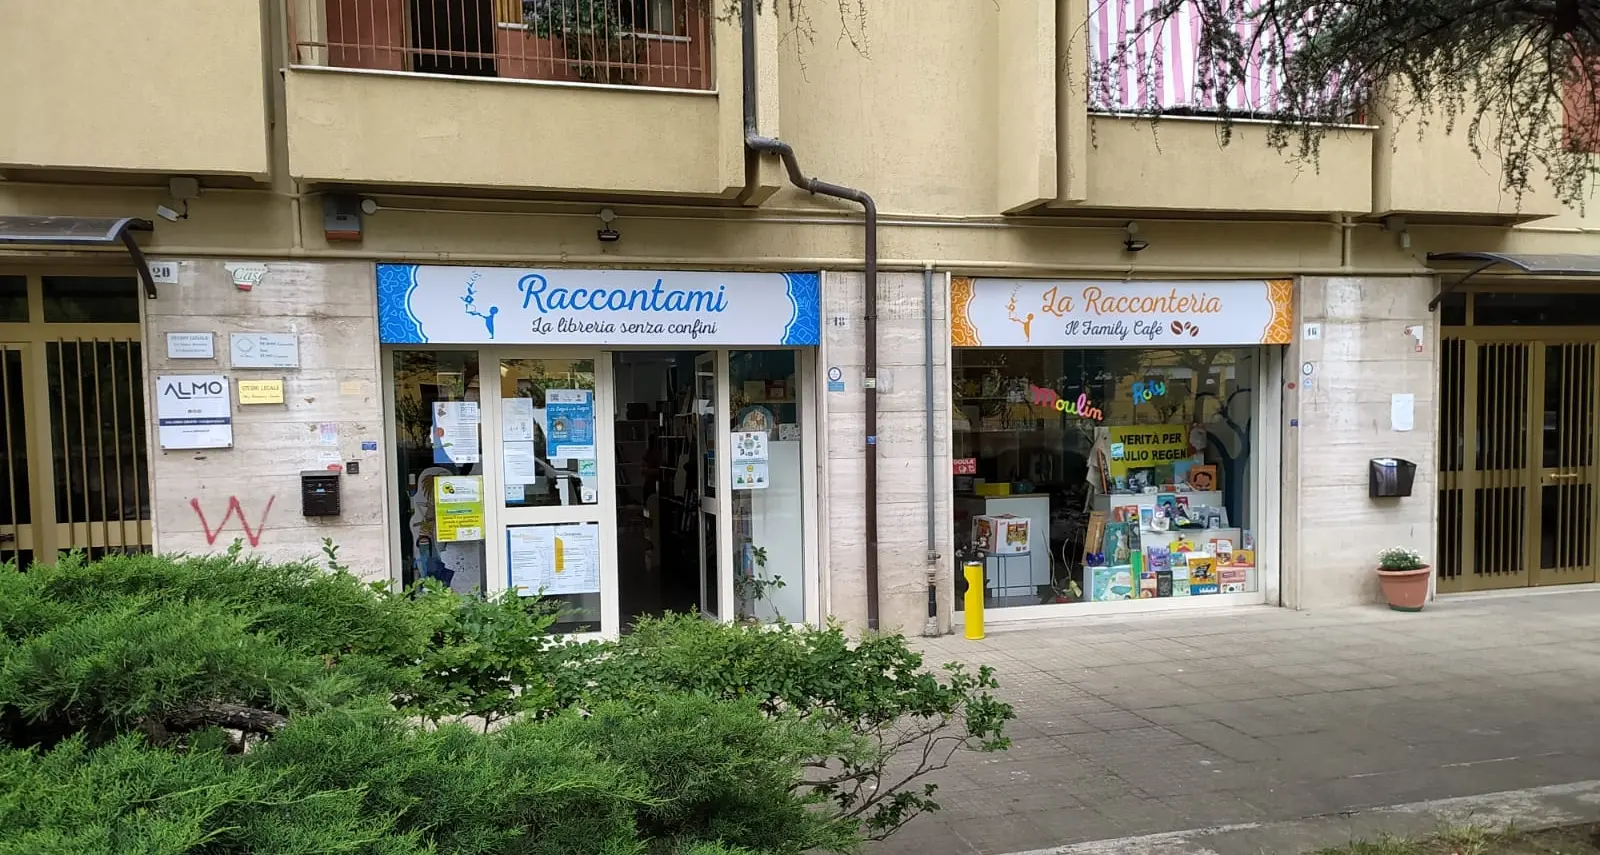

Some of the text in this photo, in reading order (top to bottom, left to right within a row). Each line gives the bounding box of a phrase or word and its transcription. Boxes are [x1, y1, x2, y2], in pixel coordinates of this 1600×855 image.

[518, 273, 729, 313] Raccontami
[1041, 285, 1222, 317] La Racconteria
[531, 316, 718, 340] La libreria senza confini
[1064, 319, 1164, 341] Il Family Café
[164, 381, 223, 400] ALMO
[1029, 380, 1166, 420] Moulin Roty
[1120, 432, 1182, 445] VERITÀ PER
[190, 494, 276, 548] W
